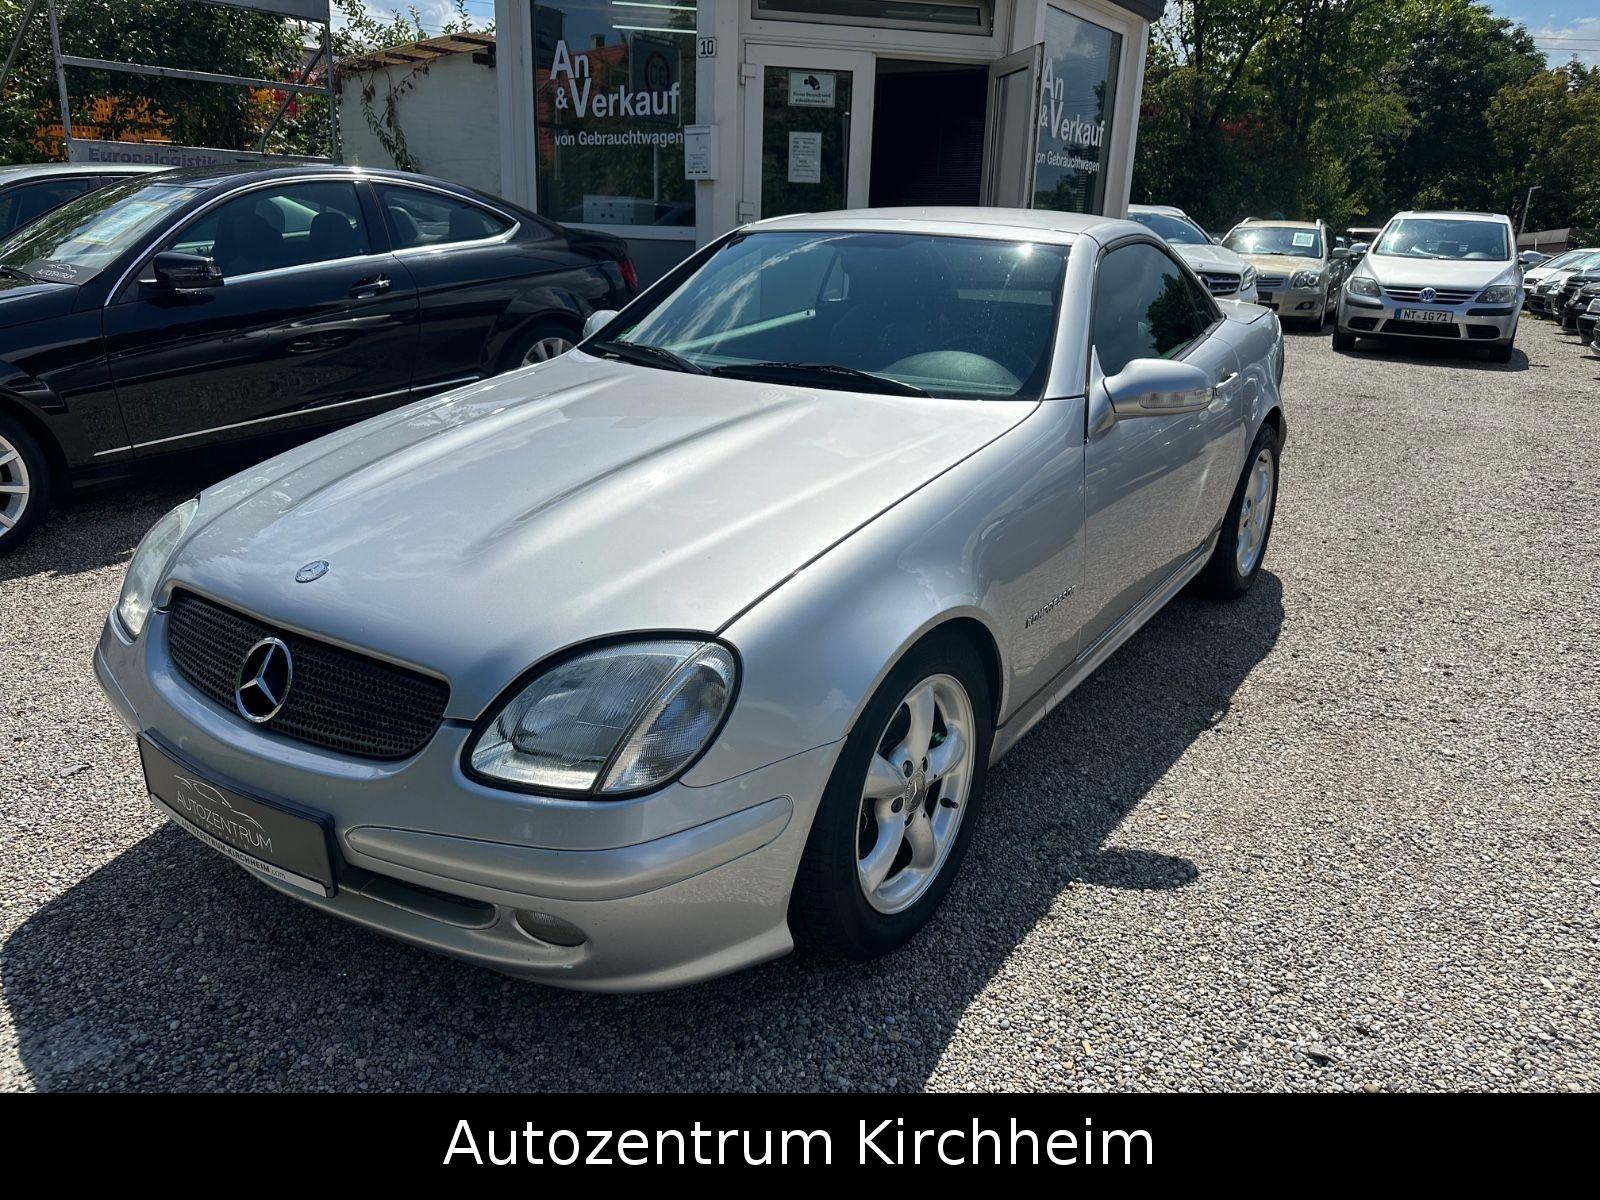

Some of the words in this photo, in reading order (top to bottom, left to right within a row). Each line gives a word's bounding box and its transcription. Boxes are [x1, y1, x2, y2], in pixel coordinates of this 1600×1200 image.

[550, 39, 589, 80] An
[700, 40, 713, 55] 10
[555, 86, 568, 109] &
[569, 77, 680, 118] Verkauf
[1041, 57, 1064, 101] An
[555, 134, 575, 146] von
[578, 130, 684, 148] Gebrauchtwagen
[1040, 104, 1048, 128] &
[1050, 99, 1105, 147] Verkauf
[1047, 150, 1100, 174] Gebrauchtwagen
[1403, 309, 1417, 319] NT
[177, 791, 273, 853] AUTOZENTRUM
